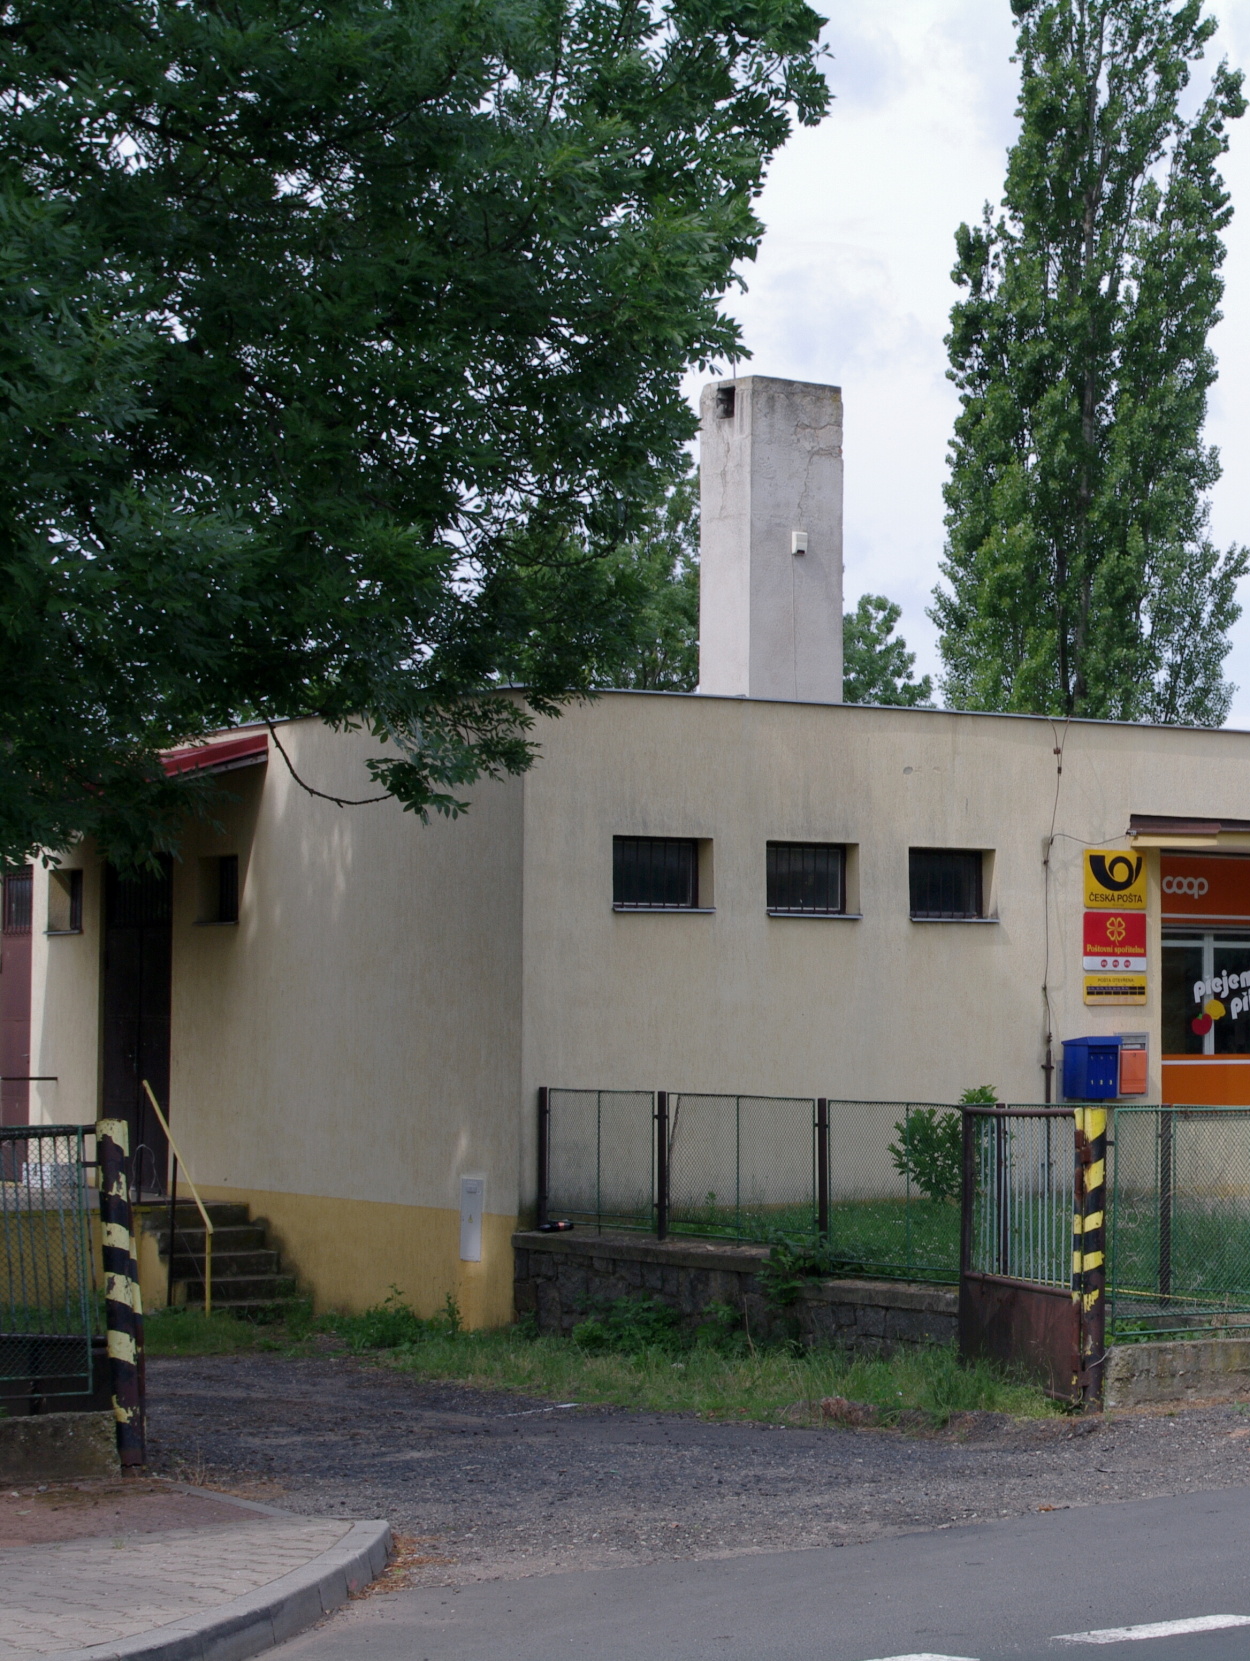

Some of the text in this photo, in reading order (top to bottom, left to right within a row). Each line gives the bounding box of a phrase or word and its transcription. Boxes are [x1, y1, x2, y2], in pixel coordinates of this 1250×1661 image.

[1162, 875, 1209, 900] coop
[1089, 892, 1143, 904] ČESKÁ POŠTA
[1086, 943, 1145, 955] Poštovní spořitelna
